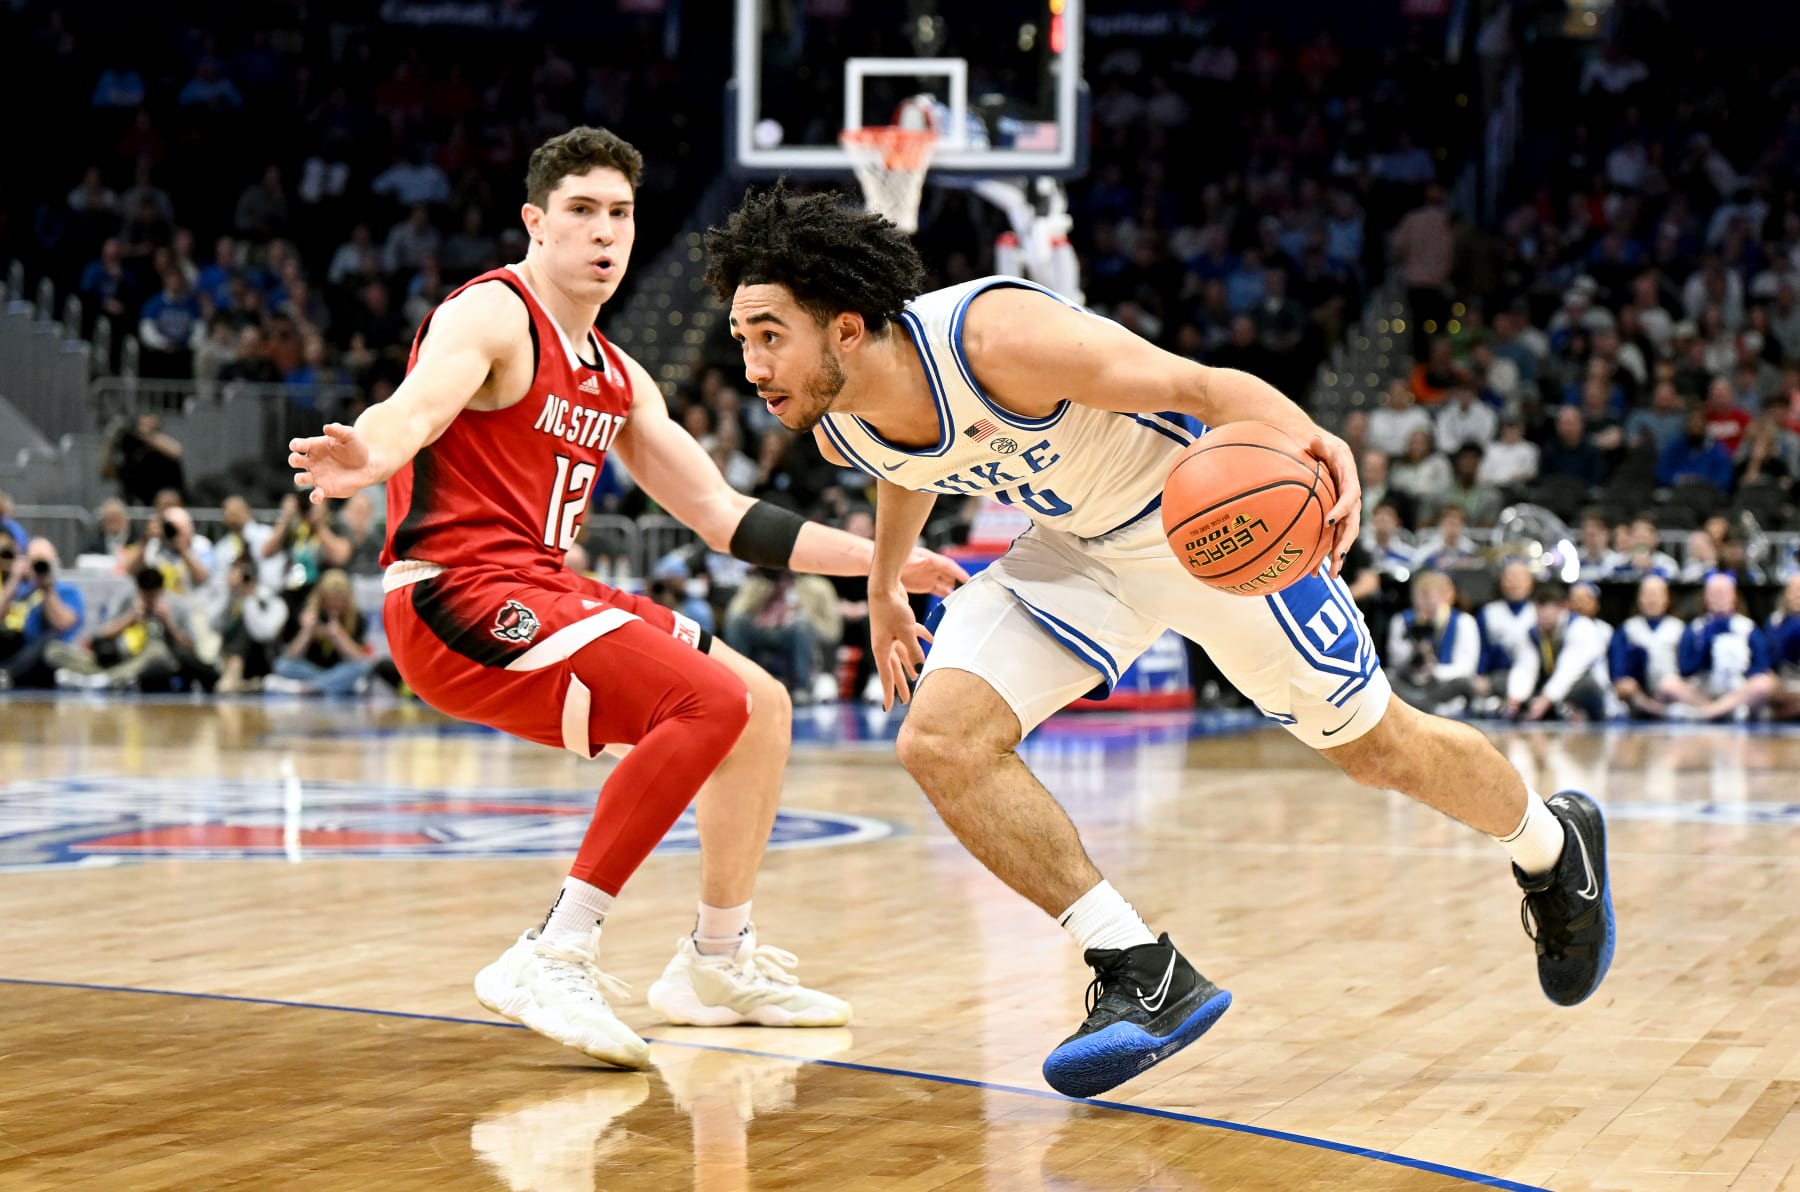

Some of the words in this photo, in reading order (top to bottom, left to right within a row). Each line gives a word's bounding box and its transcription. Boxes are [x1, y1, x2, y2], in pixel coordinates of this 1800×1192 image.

[533, 393, 569, 437] NC
[917, 439, 1061, 495] UKE
[543, 454, 596, 552] 12
[1185, 525, 1230, 551] 1000
[1188, 518, 1269, 568] LEGACY
[1305, 599, 1348, 652] D
